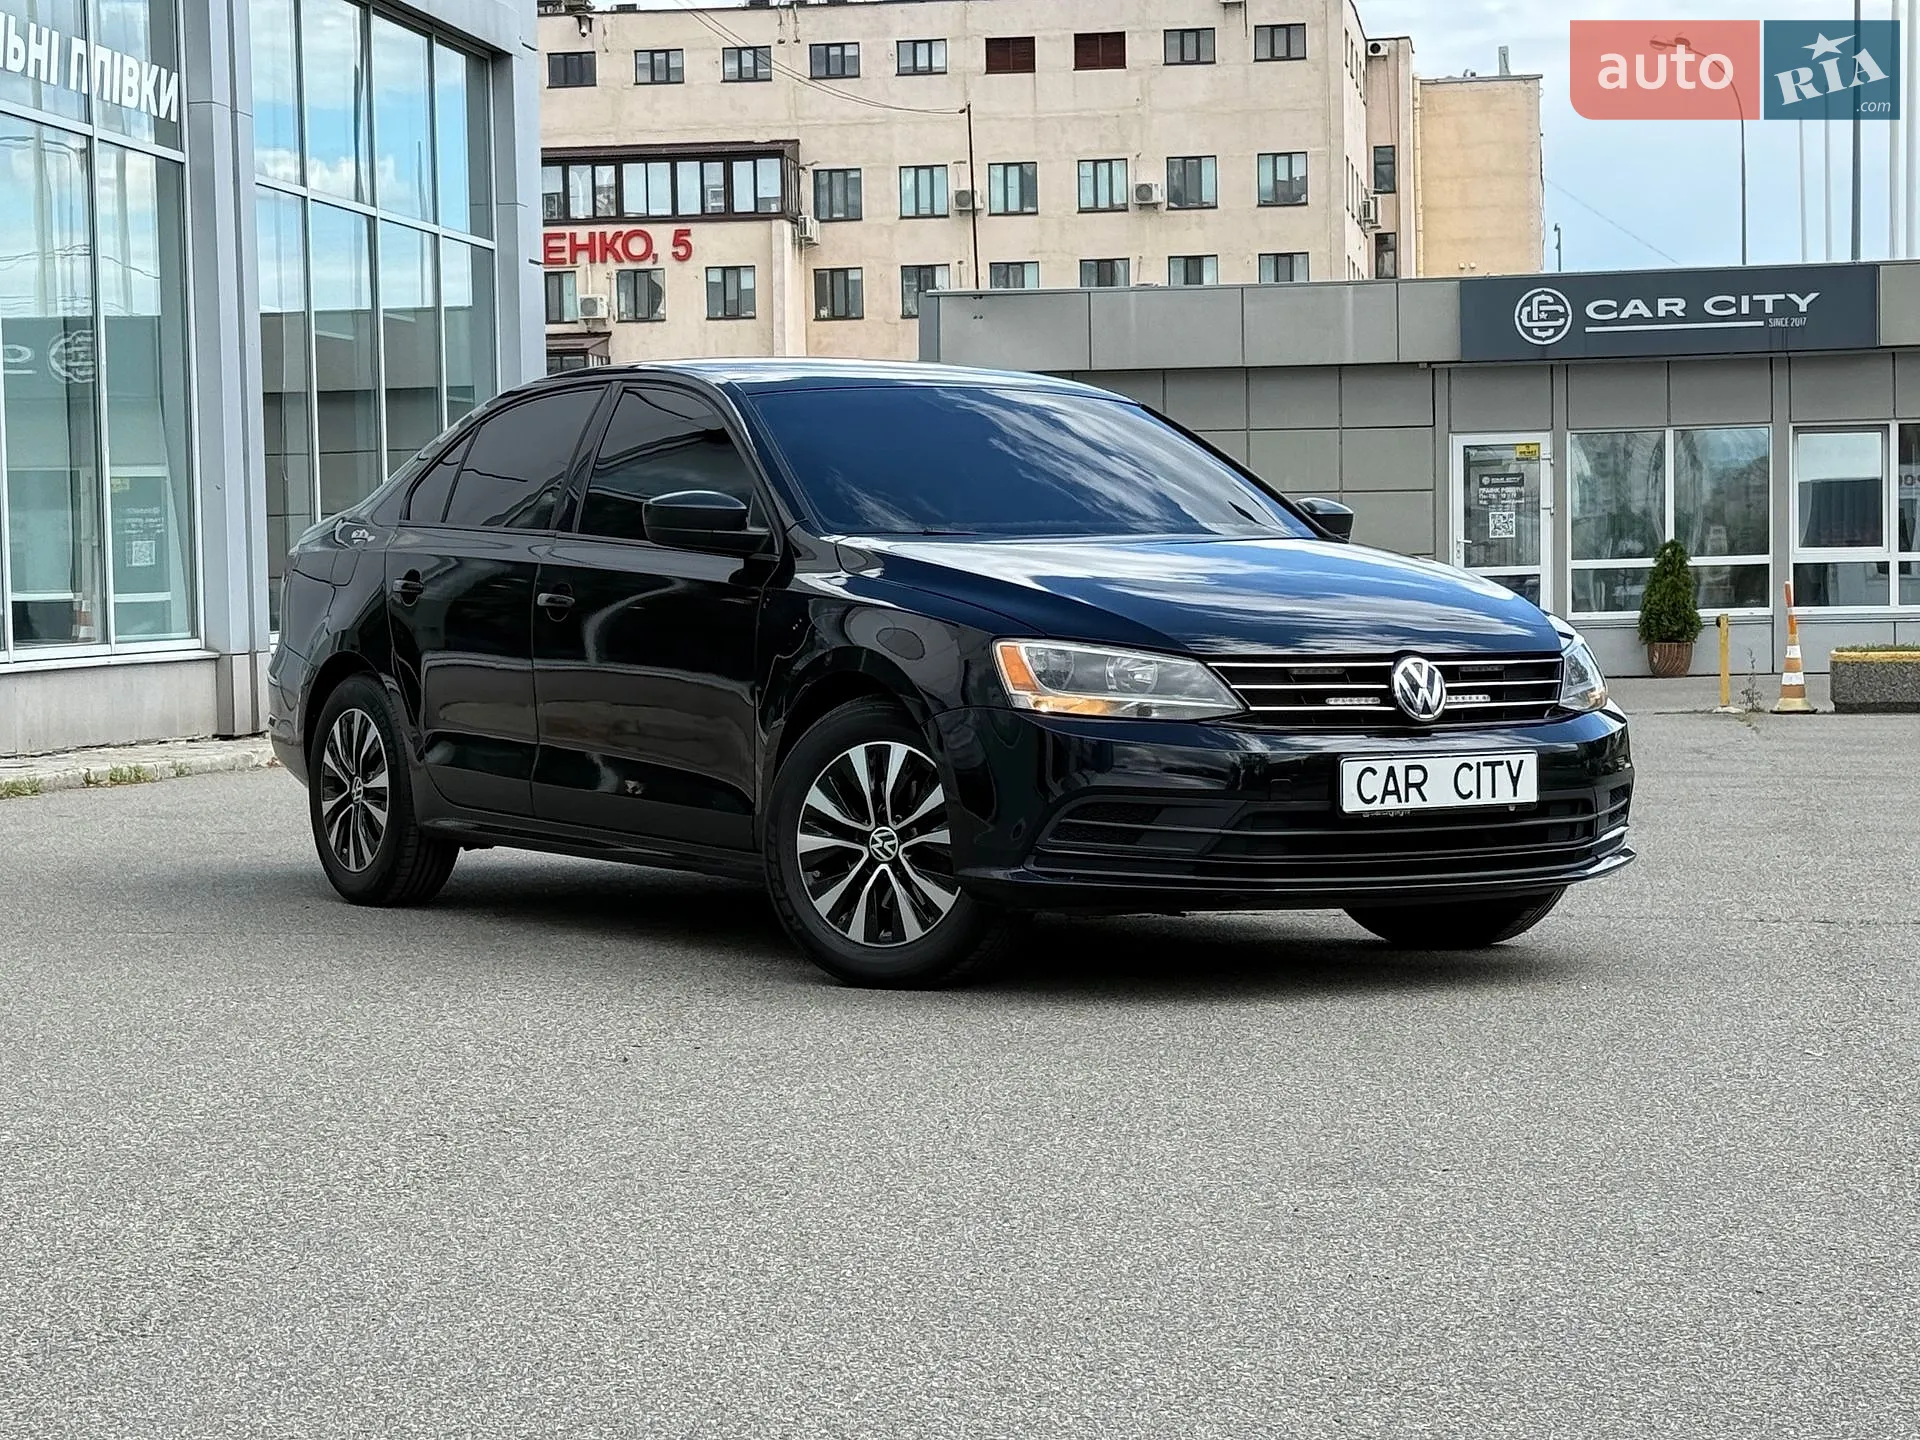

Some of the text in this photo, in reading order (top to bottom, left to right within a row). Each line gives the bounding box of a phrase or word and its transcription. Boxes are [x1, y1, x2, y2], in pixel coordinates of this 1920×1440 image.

[69, 36, 179, 123] ПЛІВКИ
[671, 228, 693, 262] 5
[1584, 292, 1821, 320] CAR CITY
[1768, 316, 1807, 328] SINCE 2017
[1356, 759, 1525, 805] CAR CITY
